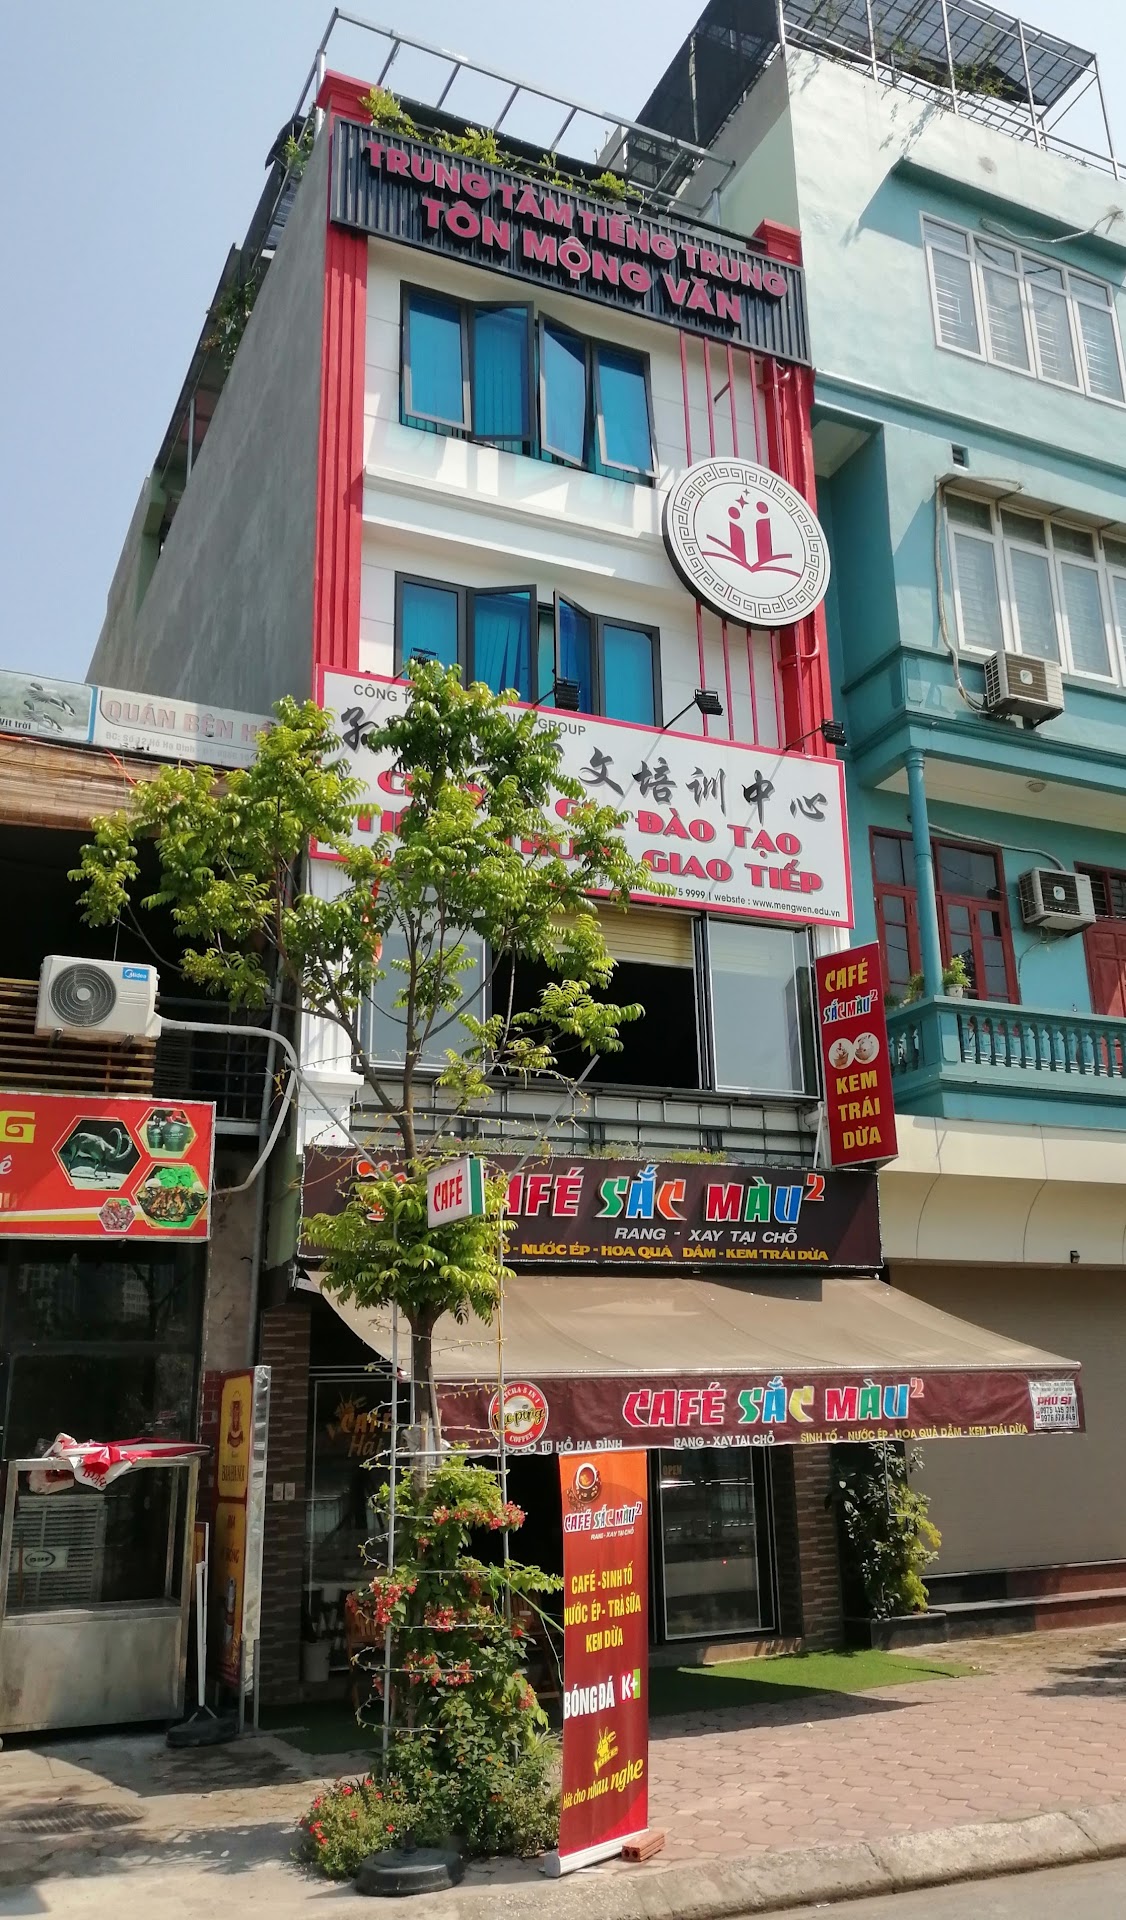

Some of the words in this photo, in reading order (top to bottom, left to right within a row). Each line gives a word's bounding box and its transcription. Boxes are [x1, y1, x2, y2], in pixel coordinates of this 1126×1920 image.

[366, 140, 491, 199] TRUNG
[498, 184, 573, 229] TÂM
[578, 210, 677, 260] TIẾNG
[681, 242, 788, 297] TRUNG
[422, 196, 511, 251] TÔN
[522, 229, 651, 293] MỘNG
[662, 272, 741, 324] VĂN
[354, 684, 397, 702] CÔNG
[104, 700, 176, 730] QUÁN
[537, 718, 586, 736] GROUP
[635, 807, 715, 843] ĐÀO
[727, 824, 801, 858] TẠO
[642, 849, 733, 882] GIAO
[744, 859, 823, 893] TIẾP
[686, 888, 706, 899] 9999
[714, 892, 746, 905] website
[752, 898, 841, 917] www.mengwen.edu.vn
[825, 958, 869, 993] CAFÉ
[823, 998, 845, 1024] SẮC
[836, 1069, 878, 1095] KEM
[838, 1098, 881, 1122] TRÁI
[842, 1125, 882, 1150] DỪA
[433, 1169, 463, 1213] CAFÉ
[594, 1164, 687, 1221] SẮC
[521, 1240, 567, 1256] NƯỚC
[569, 1241, 591, 1256] ÉP
[601, 1245, 636, 1258] HOA
[637, 1244, 673, 1260] QUẢ
[726, 1248, 758, 1259] KEM
[759, 1246, 796, 1261] TRÁI
[797, 1247, 829, 1261] DỪA
[614, 1227, 667, 1241] RANG
[688, 1229, 724, 1242] XAY
[730, 1230, 756, 1245] TẠI
[762, 1227, 798, 1244] CHỖ
[623, 1382, 727, 1428] CAFÉ
[738, 1375, 815, 1425] SẮC
[556, 1436, 574, 1452] HỒ
[596, 1437, 623, 1449] ĐÌNH
[674, 1437, 705, 1449] RANG
[713, 1435, 733, 1447] XAY
[752, 1430, 776, 1445] CHỖ
[800, 1432, 823, 1443] SINH
[825, 1428, 838, 1442] TỐ
[848, 1428, 876, 1441] NƯỚC
[878, 1427, 889, 1439] ÉP
[895, 1428, 918, 1439] HOA
[919, 1424, 939, 1438] QUẢ
[969, 1426, 987, 1436] KEM
[989, 1422, 1008, 1435] TRÁI
[1009, 1422, 1029, 1435] DỪA
[564, 1509, 592, 1533] CAFÉ
[592, 1504, 614, 1530] SẮC
[571, 1571, 596, 1595] CAFÉ
[601, 1566, 622, 1590] SINH
[623, 1560, 633, 1585] TỐ
[564, 1601, 588, 1627] NƯỚC
[608, 1593, 625, 1618] TRÀ
[625, 1591, 642, 1615] SỮA
[586, 1631, 603, 1653] KEM
[604, 1624, 624, 1649] DỪA
[563, 1683, 600, 1720] BÓNG
[598, 1675, 616, 1710] ĐÁ
[573, 1787, 587, 1806] cho
[587, 1776, 609, 1801] nhau
[610, 1758, 644, 1793] nghe
